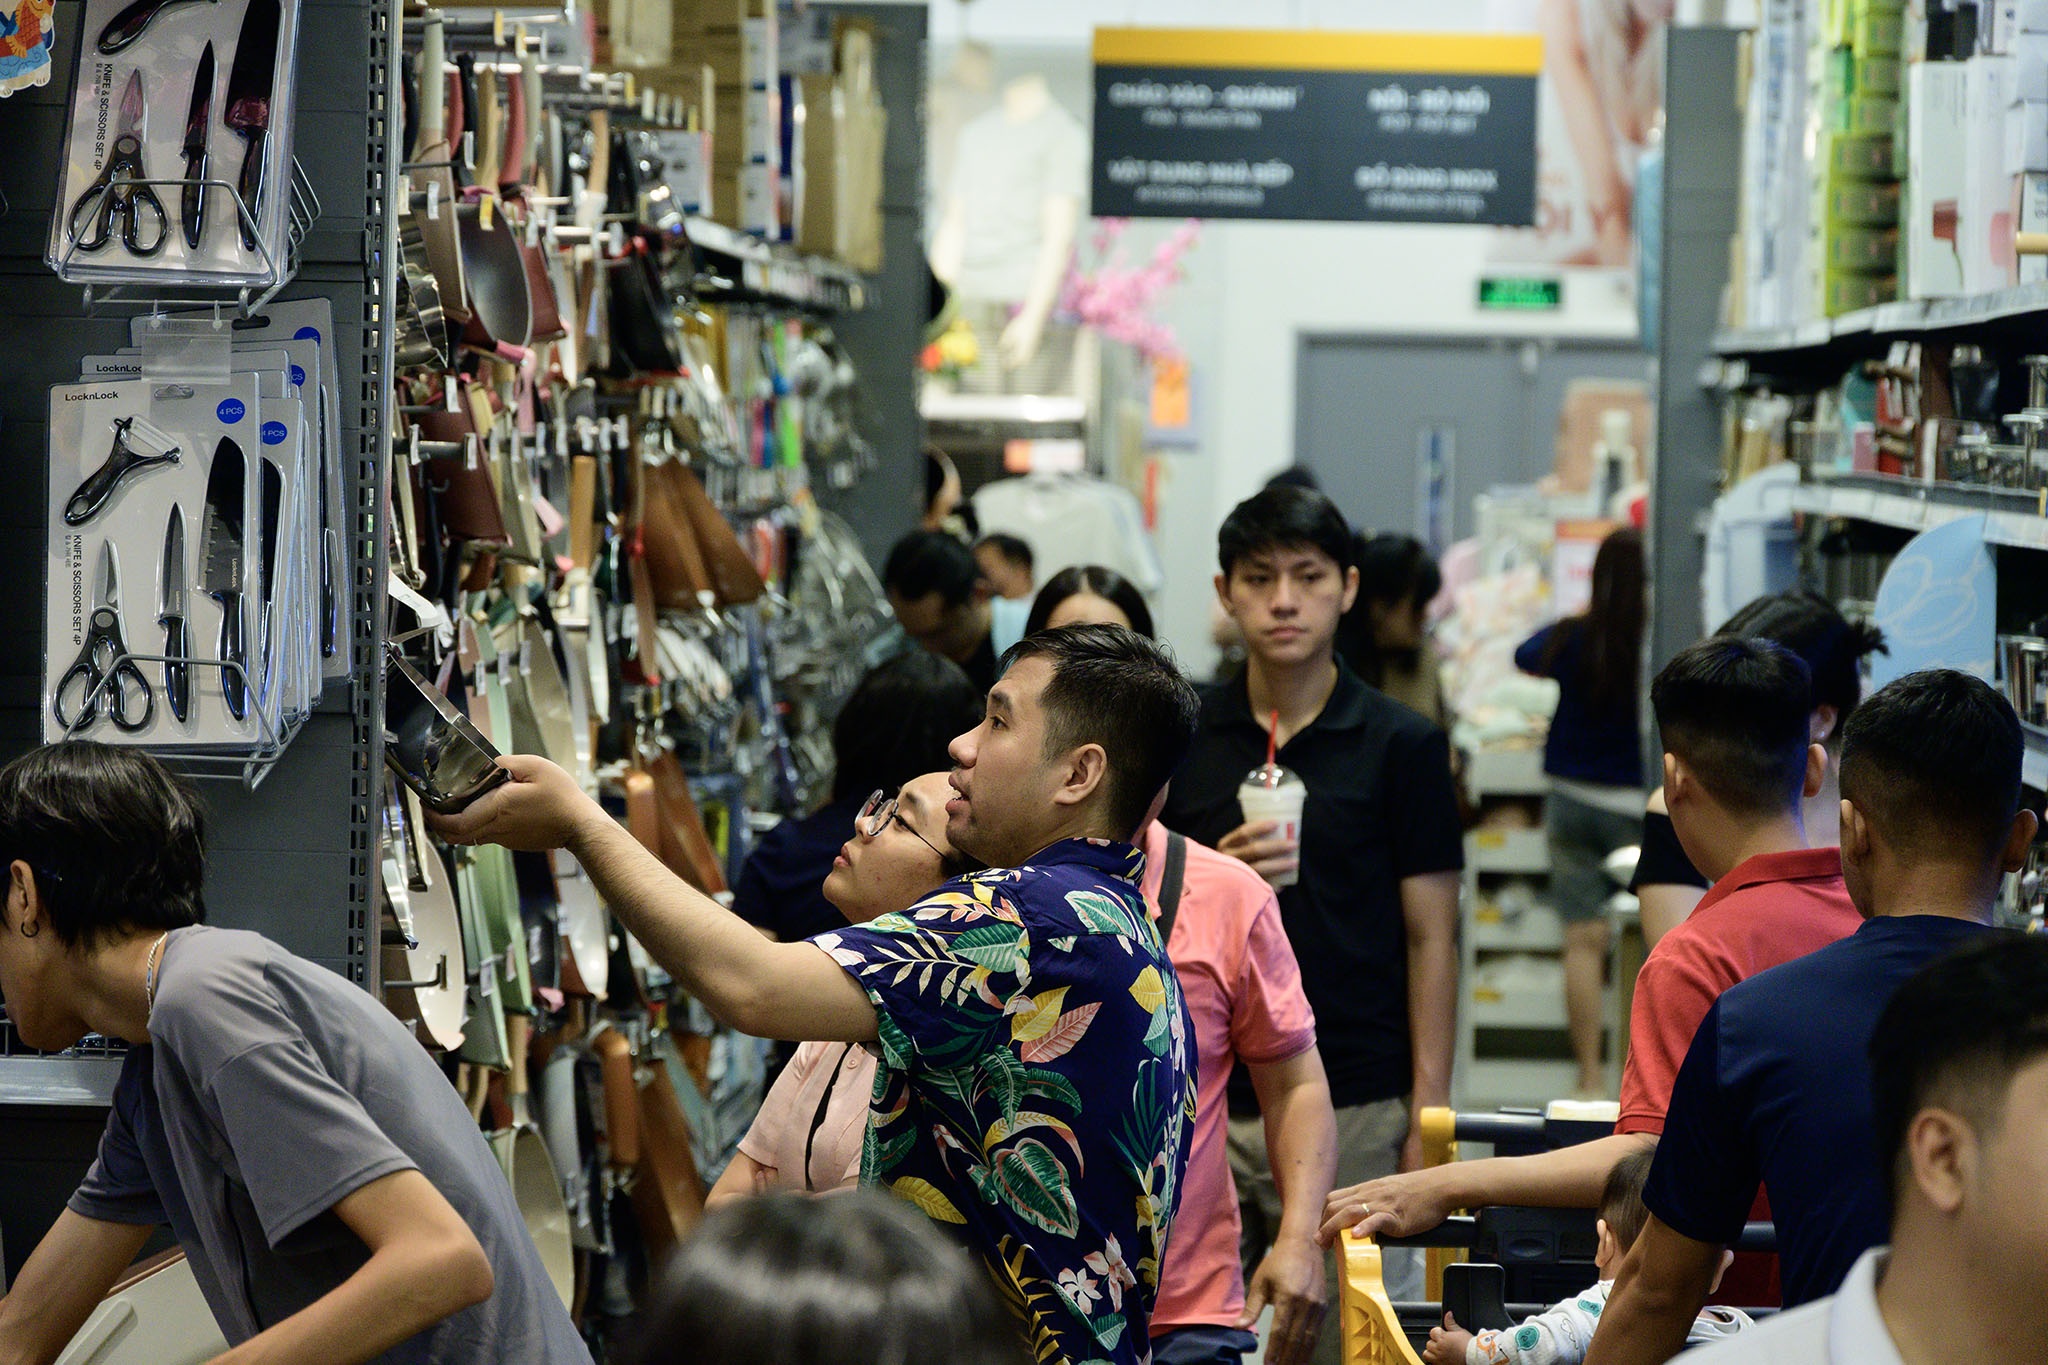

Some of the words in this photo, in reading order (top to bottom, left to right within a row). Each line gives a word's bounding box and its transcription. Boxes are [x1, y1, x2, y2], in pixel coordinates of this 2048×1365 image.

[102, 63, 113, 88] KNIFE
[96, 97, 109, 140] SCISSORS
[94, 142, 104, 158] SET
[93, 160, 102, 171] 4P
[96, 364, 142, 372] LocknLoc
[65, 391, 119, 402] LocknLock
[226, 407, 243, 415] PCS
[73, 534, 82, 560] KNIFE
[73, 570, 82, 614] SCISSORS
[73, 616, 81, 633] SET
[73, 634, 81, 646] 4P
